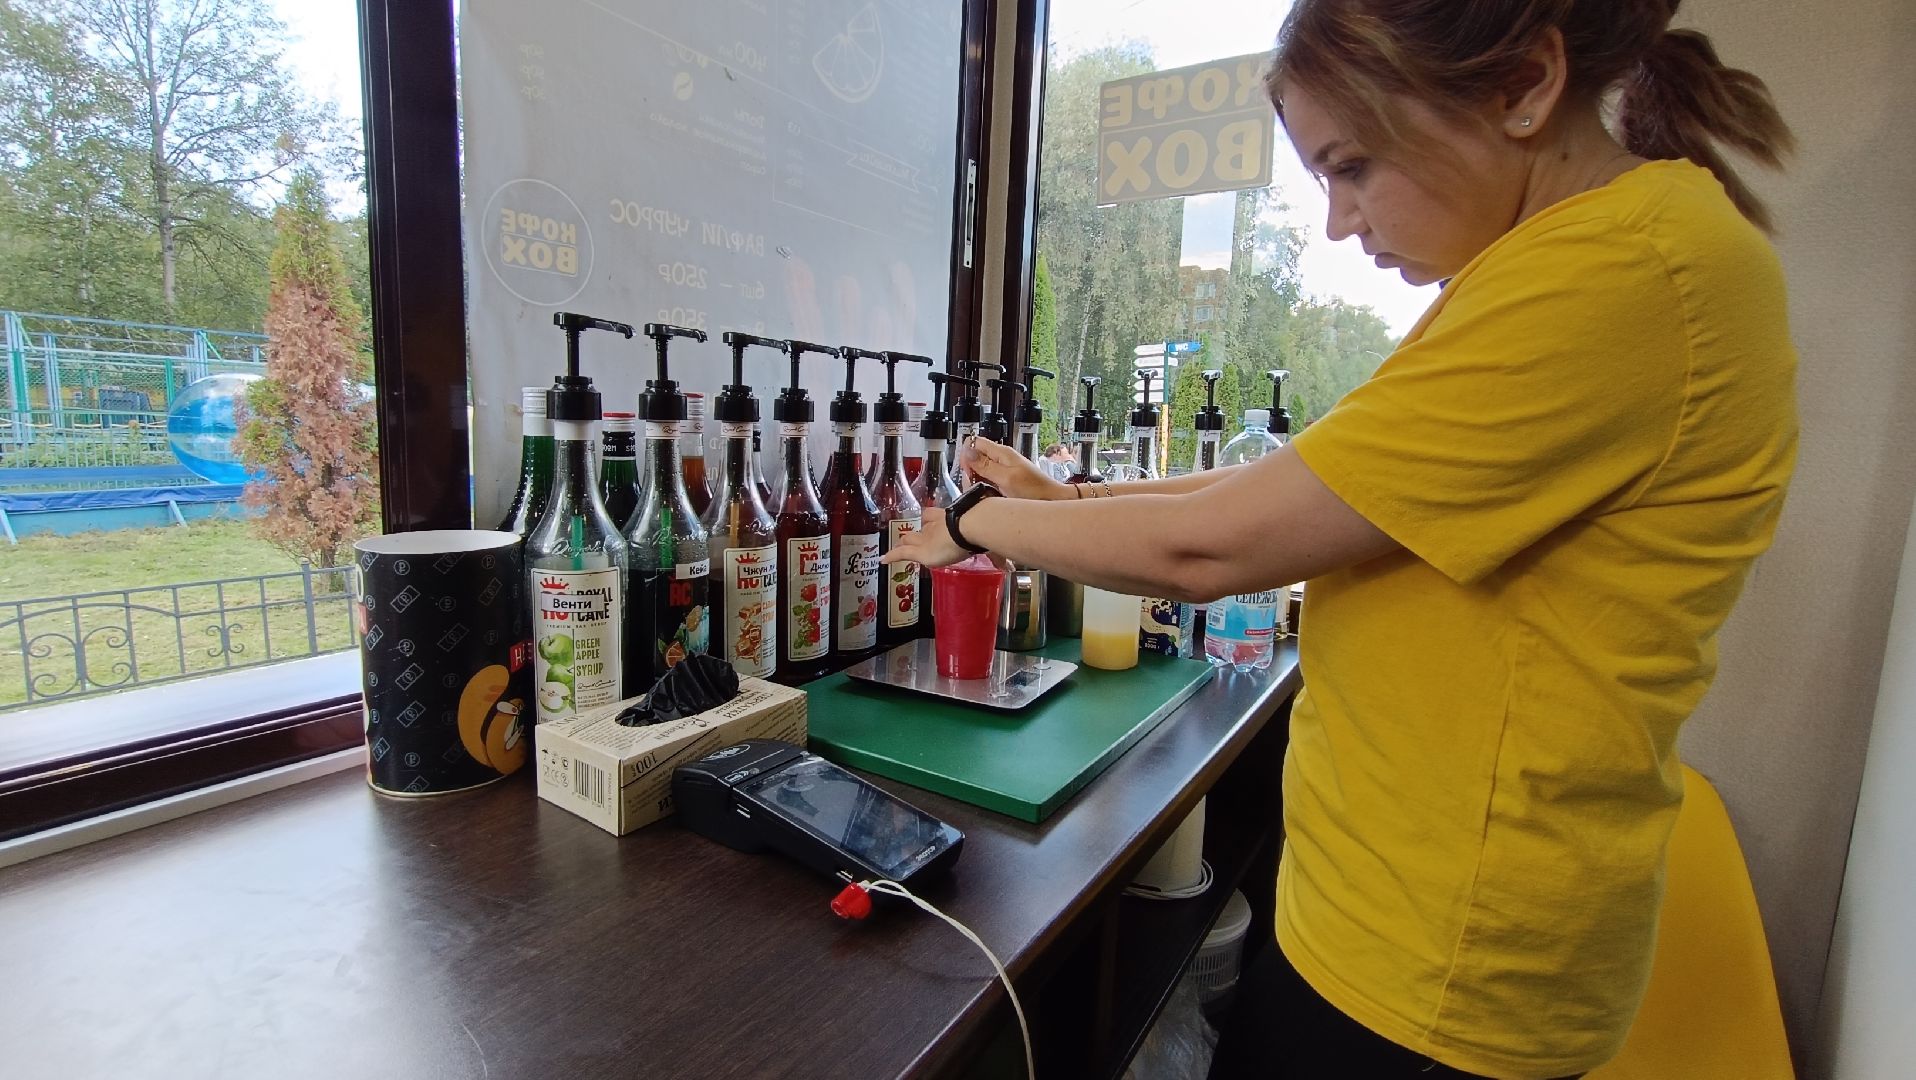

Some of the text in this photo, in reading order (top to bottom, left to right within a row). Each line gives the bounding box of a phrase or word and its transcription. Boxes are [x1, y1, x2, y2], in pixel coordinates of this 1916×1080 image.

[743, 565, 768, 577] Чжун
[553, 598, 592, 609] Венти
[575, 637, 600, 649] GREEN
[575, 649, 600, 661] APPLE
[576, 662, 604, 677] SYRUP
